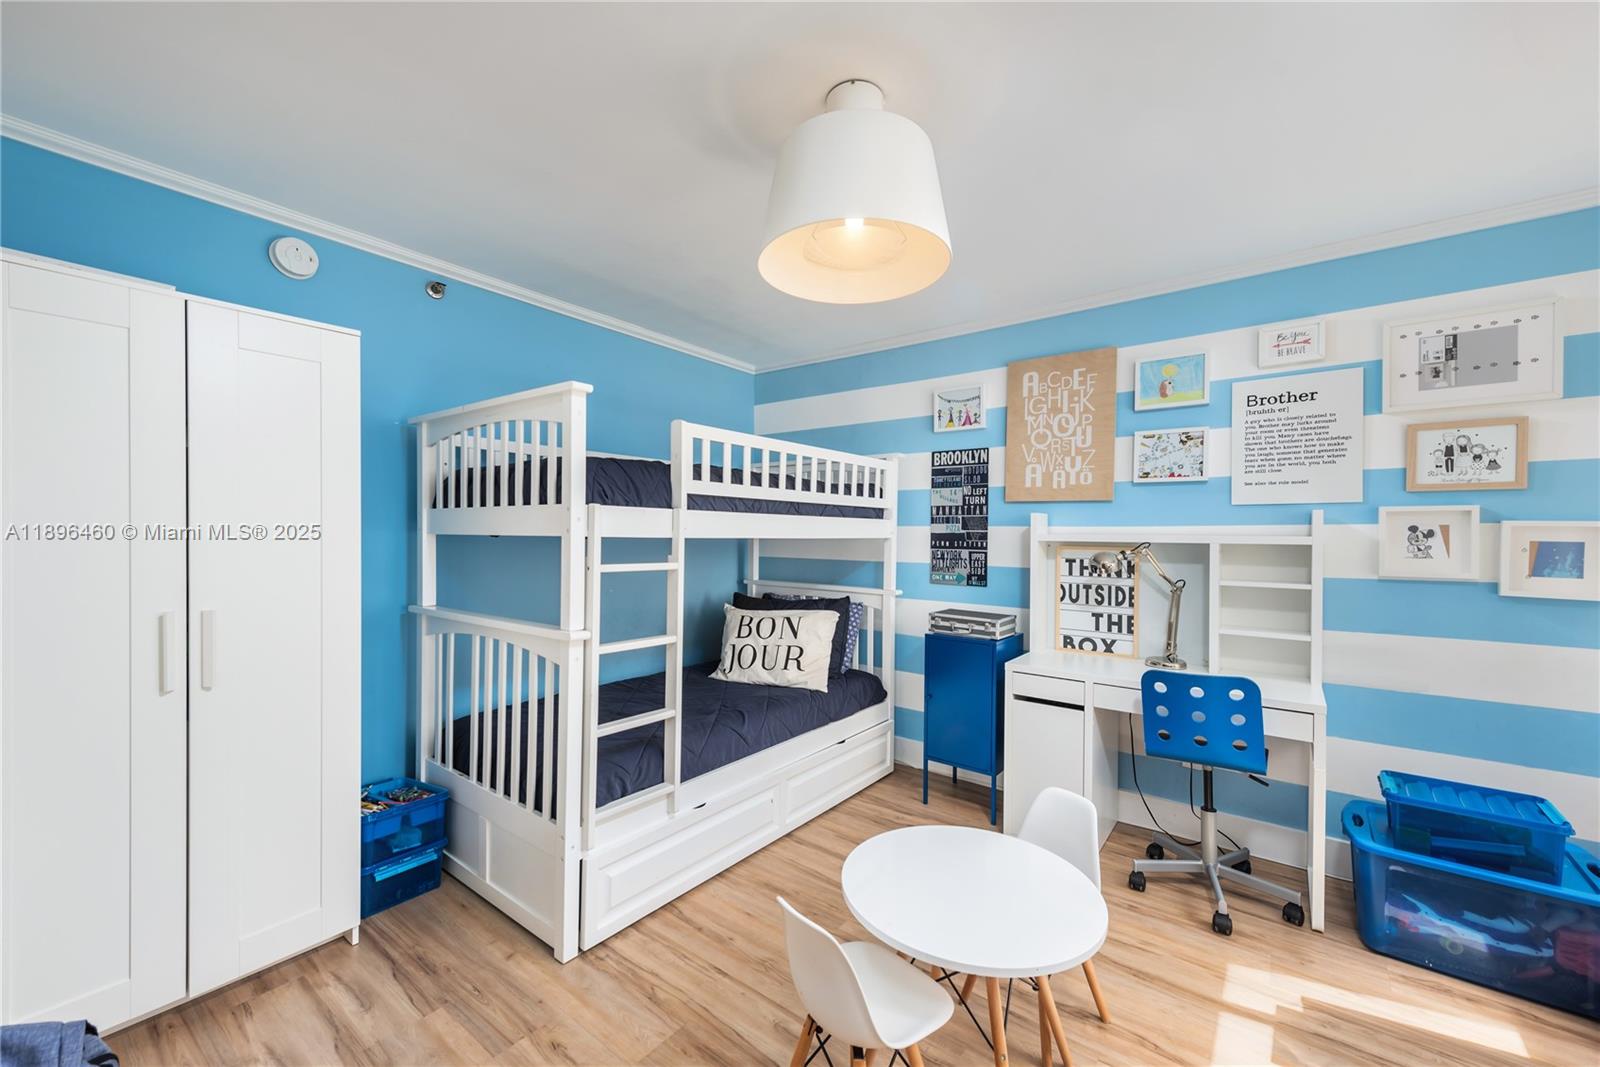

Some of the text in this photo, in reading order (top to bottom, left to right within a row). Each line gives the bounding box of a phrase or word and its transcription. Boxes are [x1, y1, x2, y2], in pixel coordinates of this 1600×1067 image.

[1247, 391, 1318, 407] Brother
[933, 449, 988, 466] BROOKLYN
[964, 485, 972, 496] NO
[973, 488, 987, 496] LEFT
[965, 496, 986, 505] TURN
[932, 505, 987, 516] MANHATTAN
[971, 560, 985, 568] EAST
[971, 567, 985, 575] SIDE
[735, 615, 802, 640] BON
[1091, 612, 1135, 635] THE
[1063, 635, 1118, 654] BOX
[723, 643, 805, 675] JOUR
